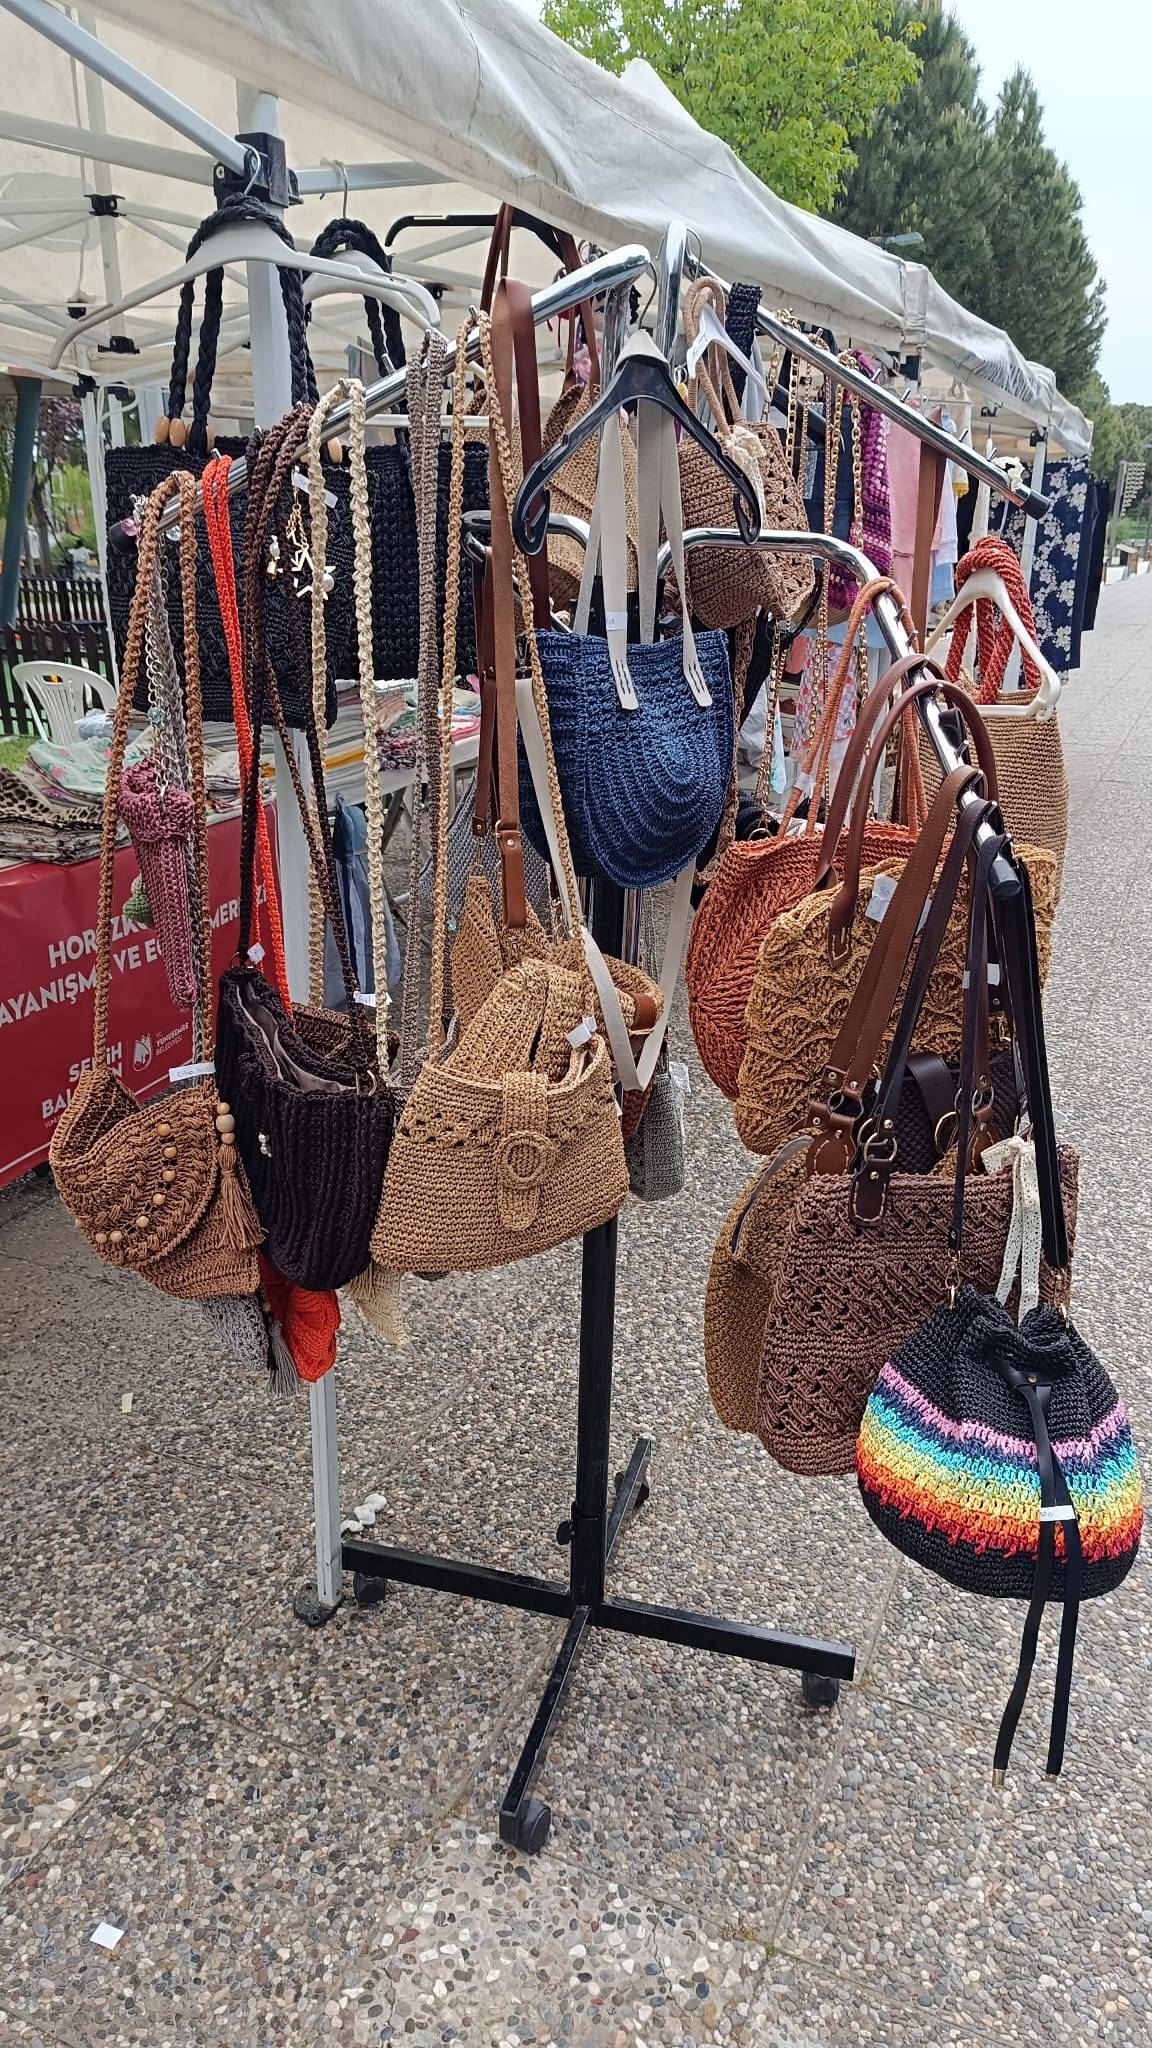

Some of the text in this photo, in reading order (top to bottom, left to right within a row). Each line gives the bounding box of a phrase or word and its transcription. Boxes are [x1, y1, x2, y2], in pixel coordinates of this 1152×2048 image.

[0, 964, 112, 1028] AYANIŞM
[113, 945, 142, 974] VE
[69, 1042, 122, 1082] SEİH
